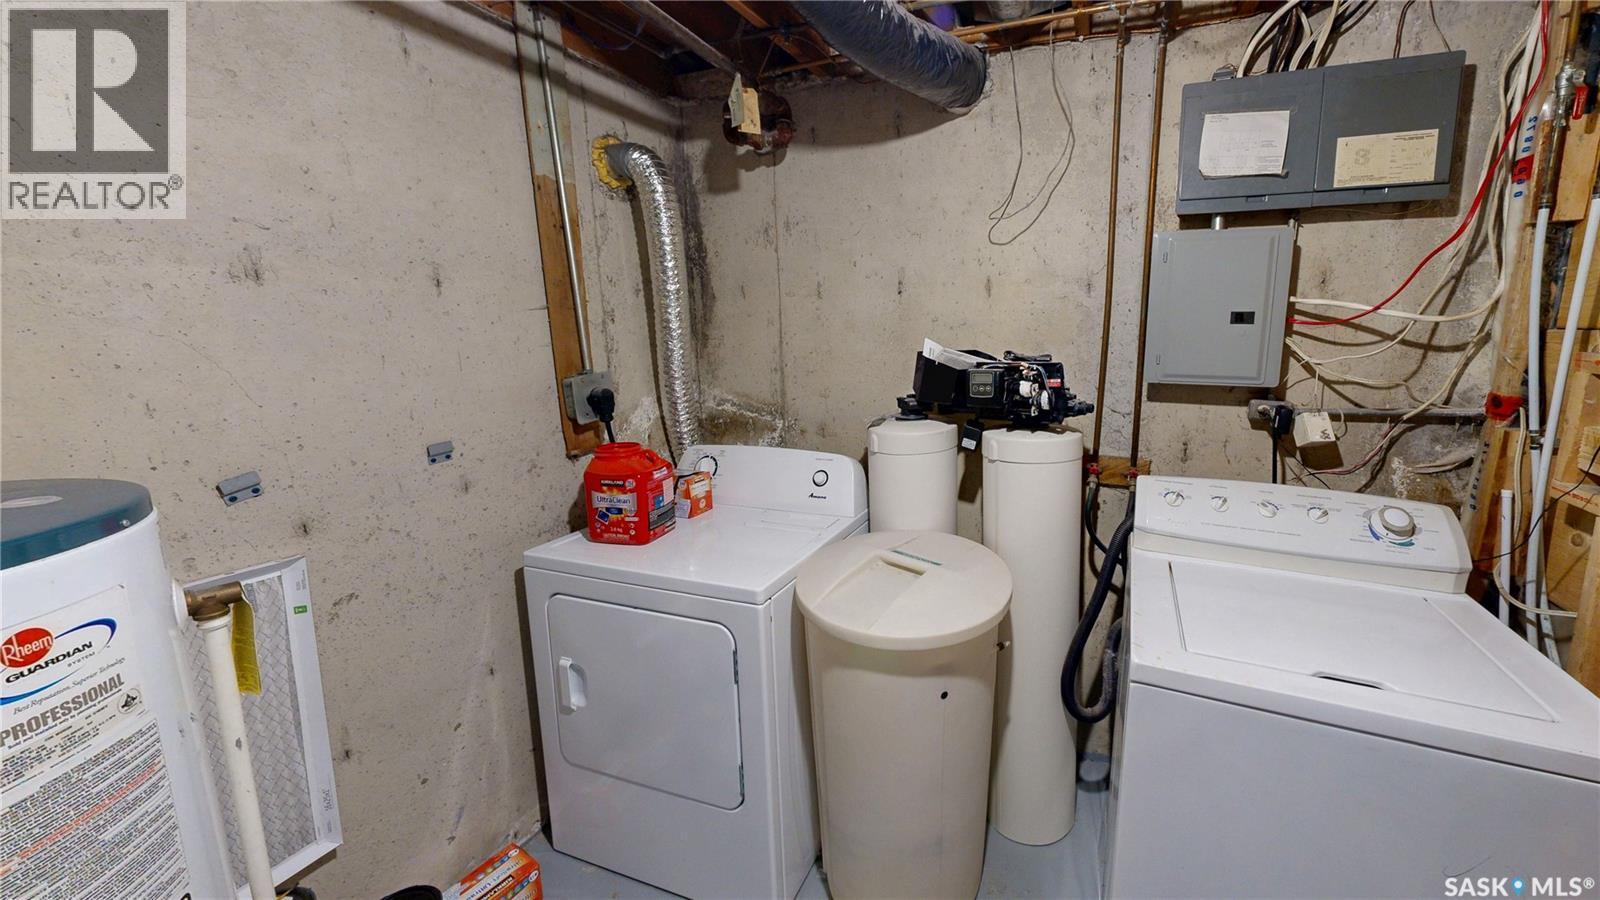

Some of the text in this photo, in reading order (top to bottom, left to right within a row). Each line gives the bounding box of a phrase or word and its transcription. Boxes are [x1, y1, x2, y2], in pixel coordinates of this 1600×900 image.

[596, 495, 631, 505] UltraClean
[1, 634, 53, 666] Rheem
[5, 640, 93, 684] GUARDIAN
[67, 651, 96, 667] SYSTEM
[0, 673, 125, 748] PROFESSIONAL
